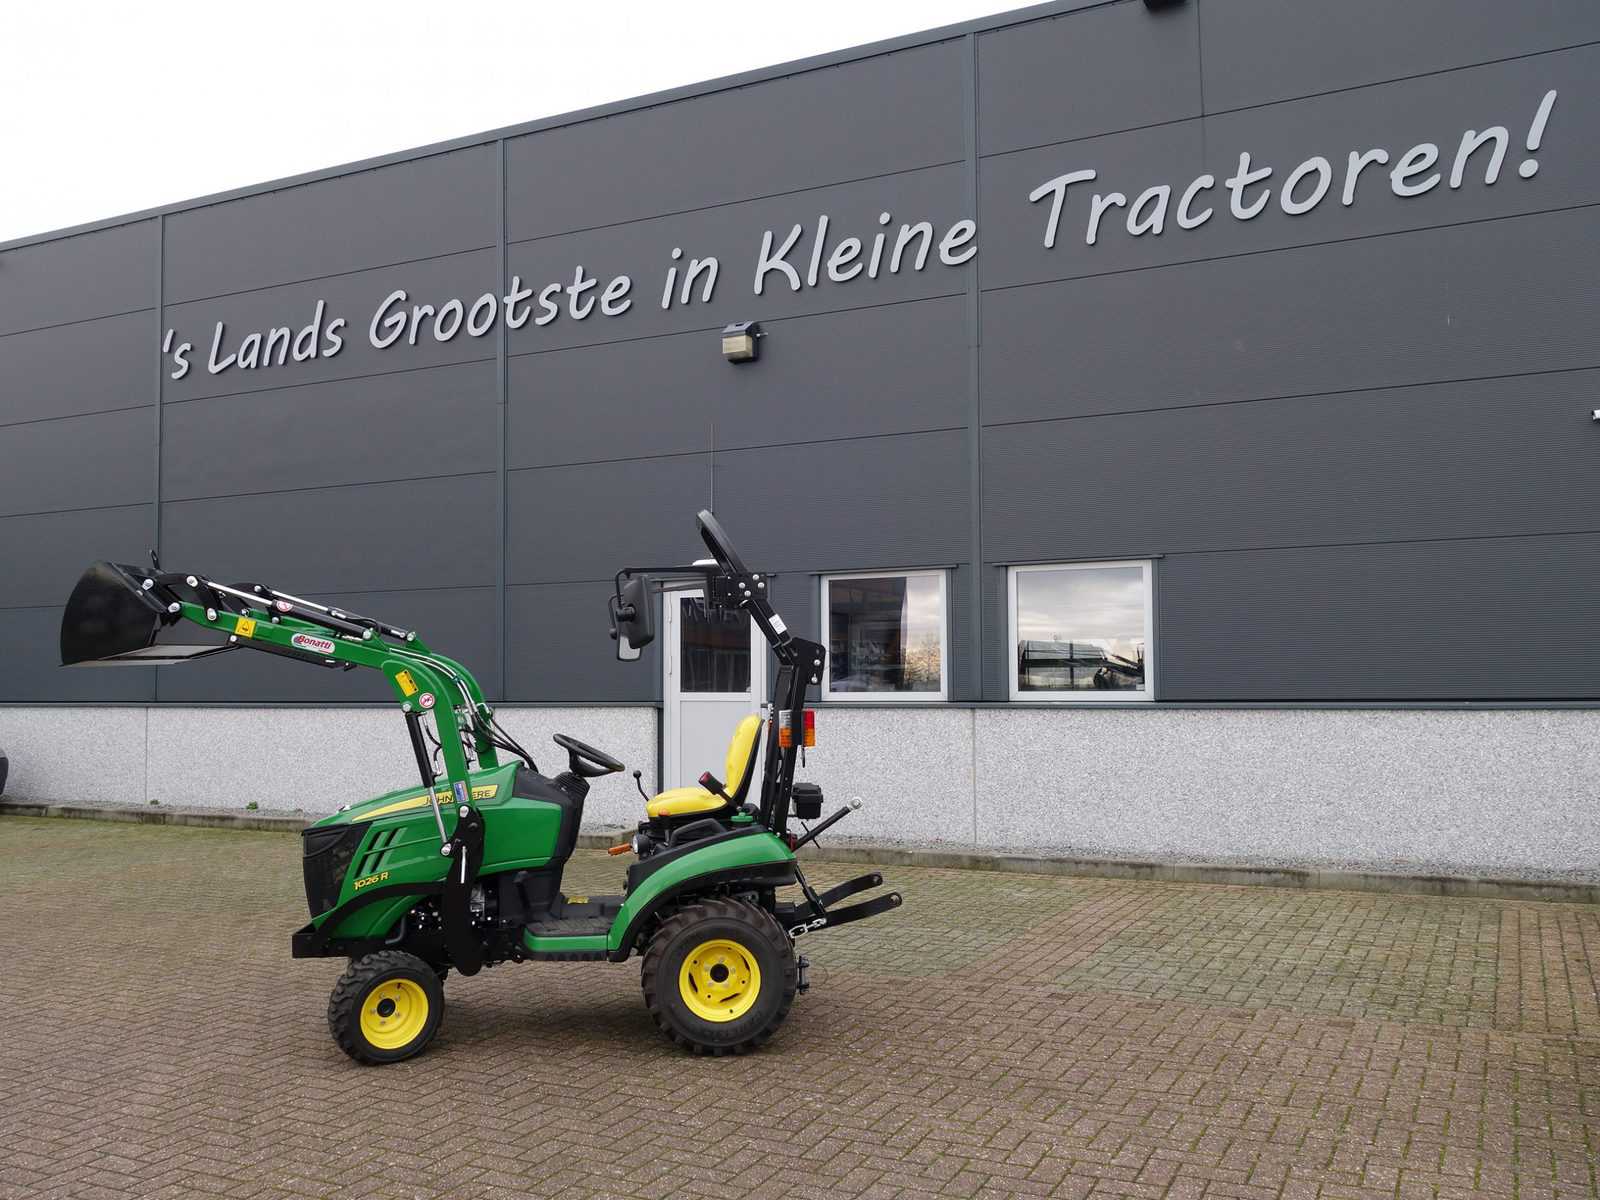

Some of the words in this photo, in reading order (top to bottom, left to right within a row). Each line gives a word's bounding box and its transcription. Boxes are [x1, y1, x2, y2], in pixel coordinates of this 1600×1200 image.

[162, 328, 192, 380] 's
[207, 299, 346, 375] Lands
[368, 264, 632, 350] Grootste
[661, 247, 719, 310] in
[753, 211, 978, 295] Kleine
[1028, 89, 1558, 248] Tractoren!
[298, 635, 333, 650] Bonatti
[425, 792, 454, 805] JHN
[353, 875, 379, 890] 1026
[380, 871, 390, 881] R
